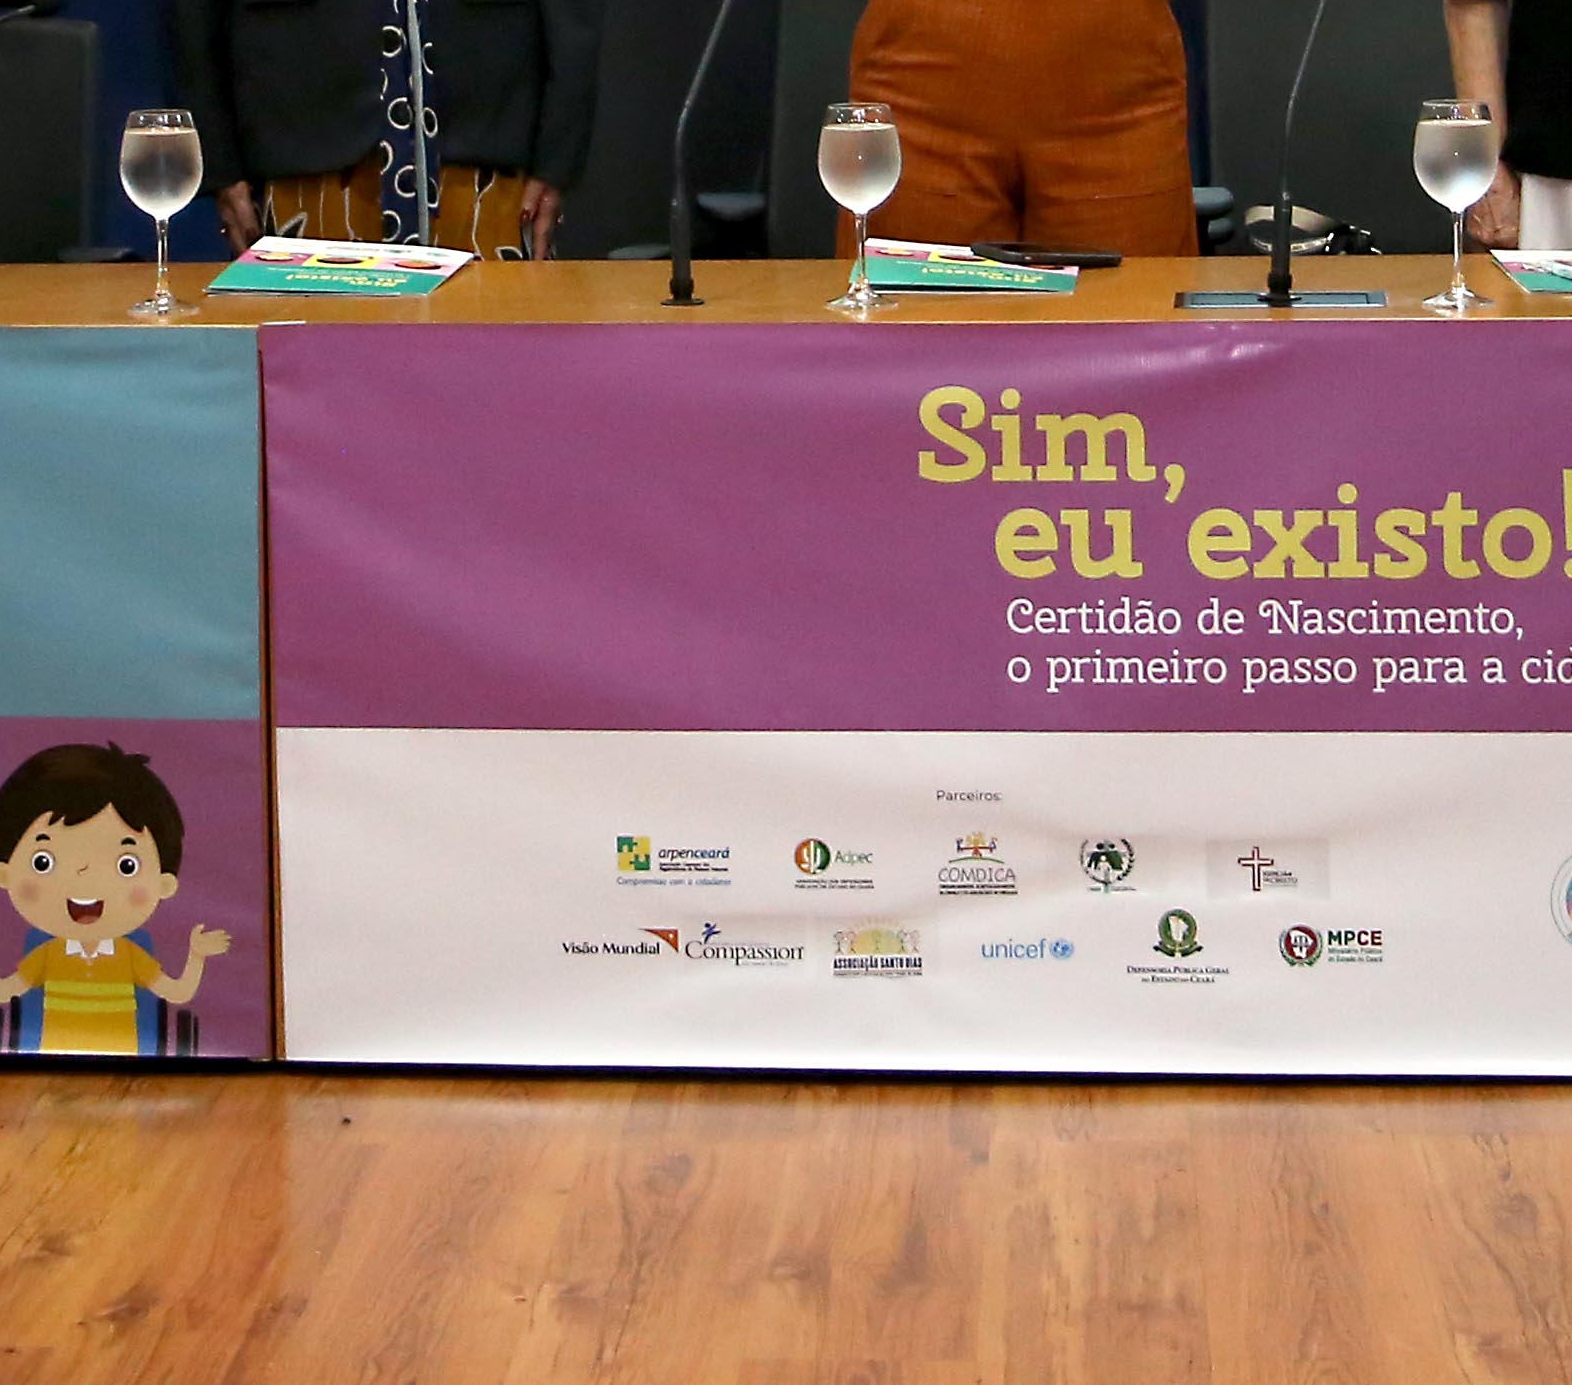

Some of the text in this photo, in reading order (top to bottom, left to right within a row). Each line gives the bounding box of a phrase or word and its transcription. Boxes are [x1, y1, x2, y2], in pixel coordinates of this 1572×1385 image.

[920, 387, 1185, 503] Sim,
[996, 509, 1144, 579] eu
[1006, 597, 1524, 642] Certidão de Nascimento,
[1006, 656, 1032, 684] o
[1045, 648, 1229, 694] primeiro
[1241, 657, 1358, 695] passo
[1371, 656, 1469, 694] para
[1482, 656, 1508, 685] a
[936, 790, 1003, 802] Parceiros:
[659, 846, 730, 863] arpenceará
[938, 867, 1016, 883] COMDICA
[562, 941, 660, 955] Visão Mundial
[981, 938, 1048, 959] unicef
[1327, 930, 1383, 946] MPCE
[684, 941, 804, 966] Compassion
